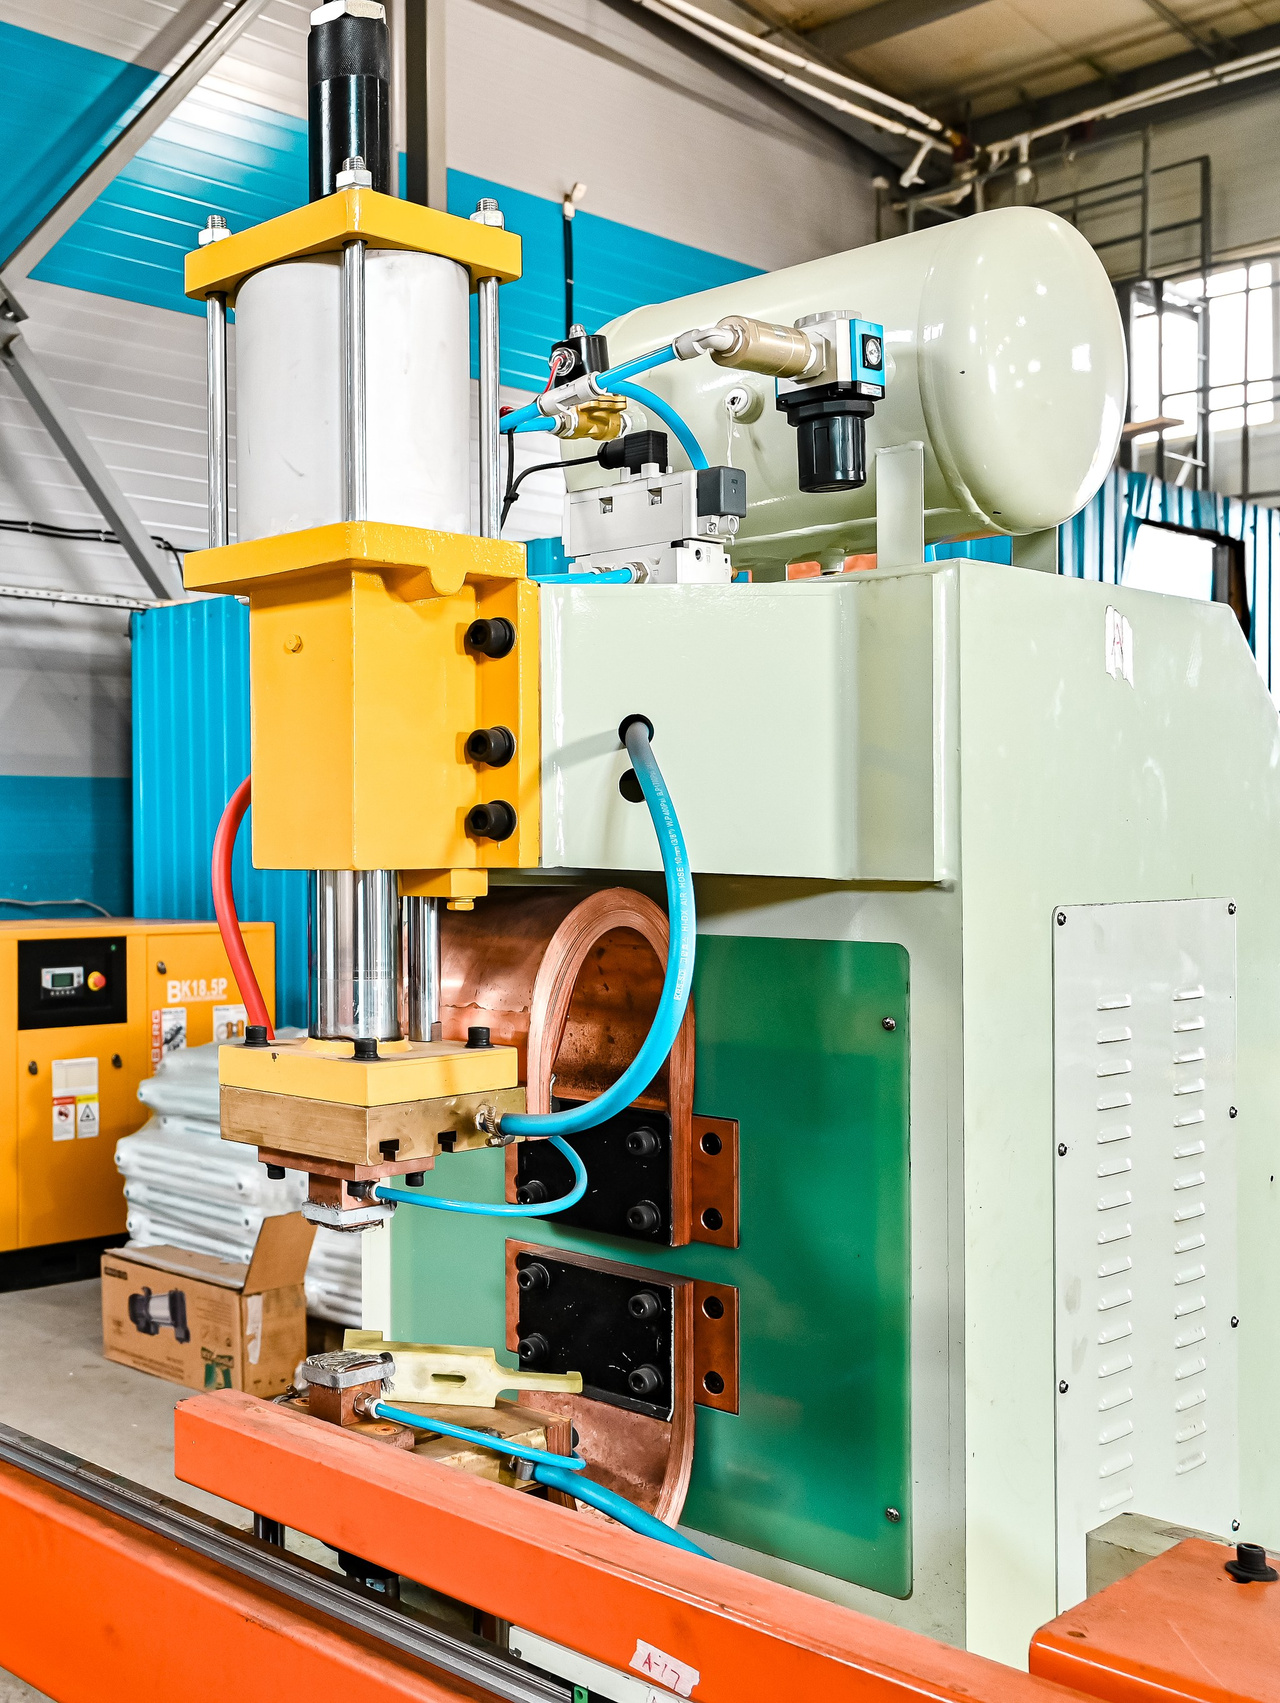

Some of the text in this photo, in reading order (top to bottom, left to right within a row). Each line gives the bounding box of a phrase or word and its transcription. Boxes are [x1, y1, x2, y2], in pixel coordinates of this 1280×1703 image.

[676, 866, 686, 888] HOSE
[679, 891, 688, 906] AIR
[680, 909, 689, 931] HI-DX
[167, 978, 228, 1003] BK18.5P
[642, 1652, 681, 1690] A-17
